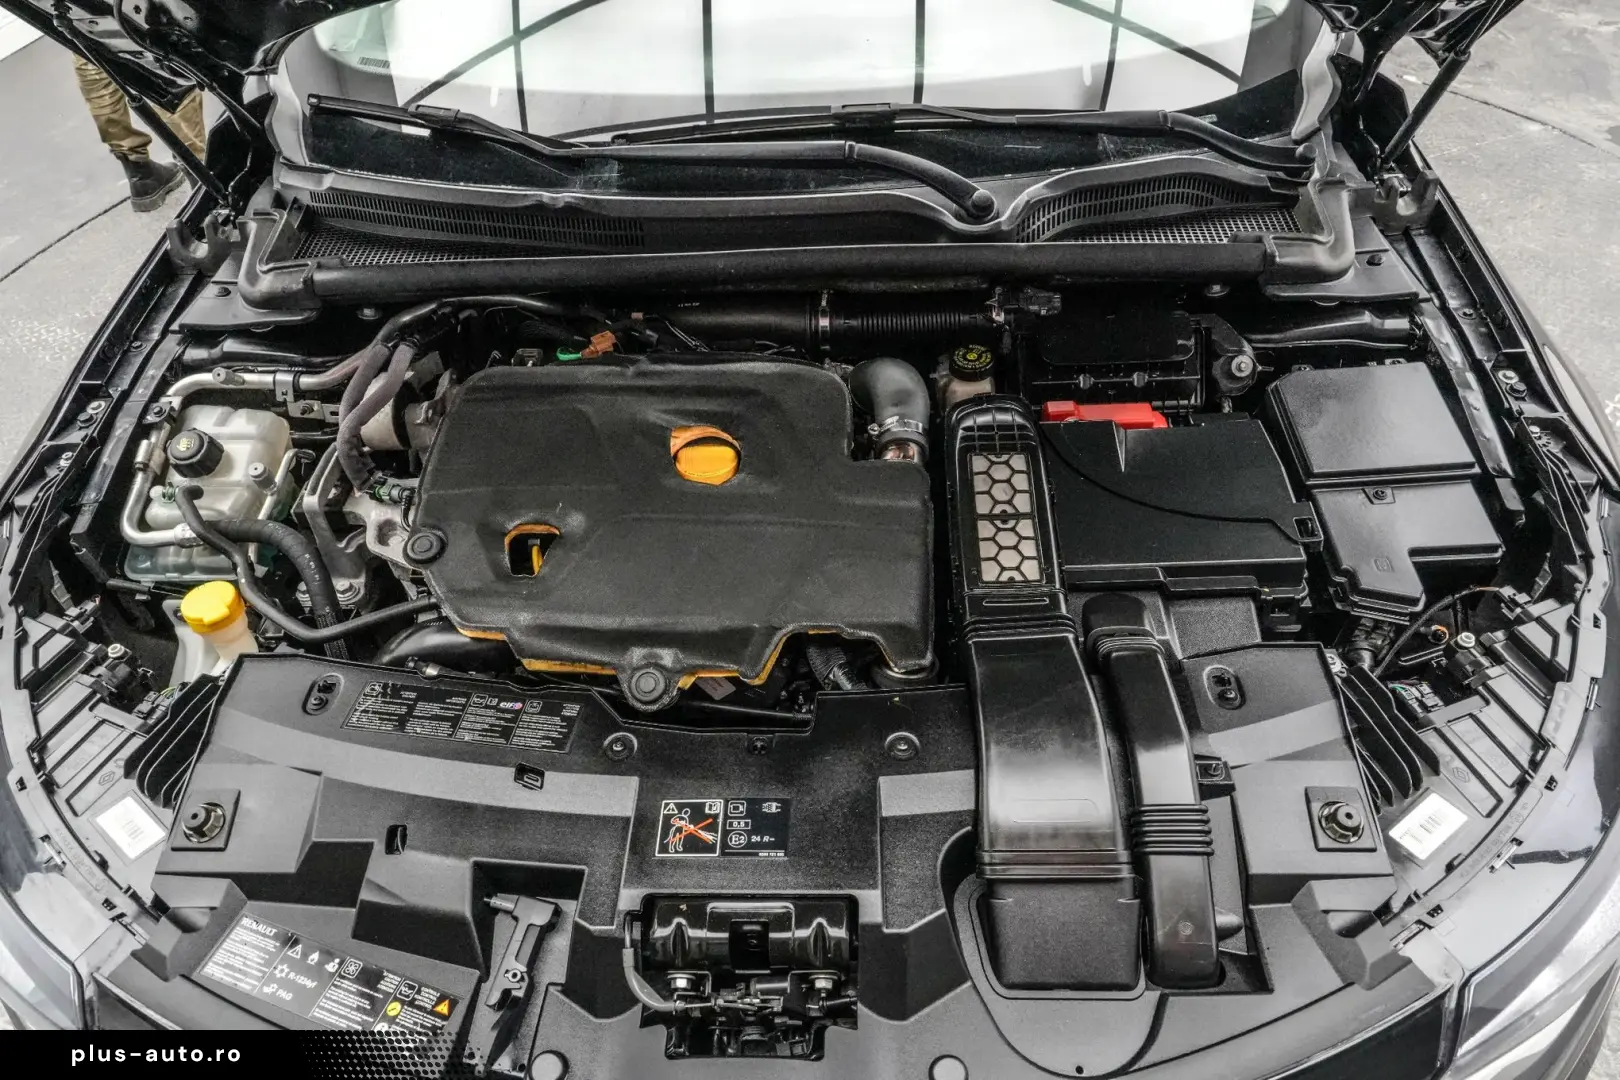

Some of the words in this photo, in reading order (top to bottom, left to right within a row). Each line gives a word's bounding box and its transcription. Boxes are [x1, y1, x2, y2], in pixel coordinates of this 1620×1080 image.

[731, 834, 745, 845] E2
[241, 917, 278, 937] RENAULT
[276, 988, 294, 1001] PAG
